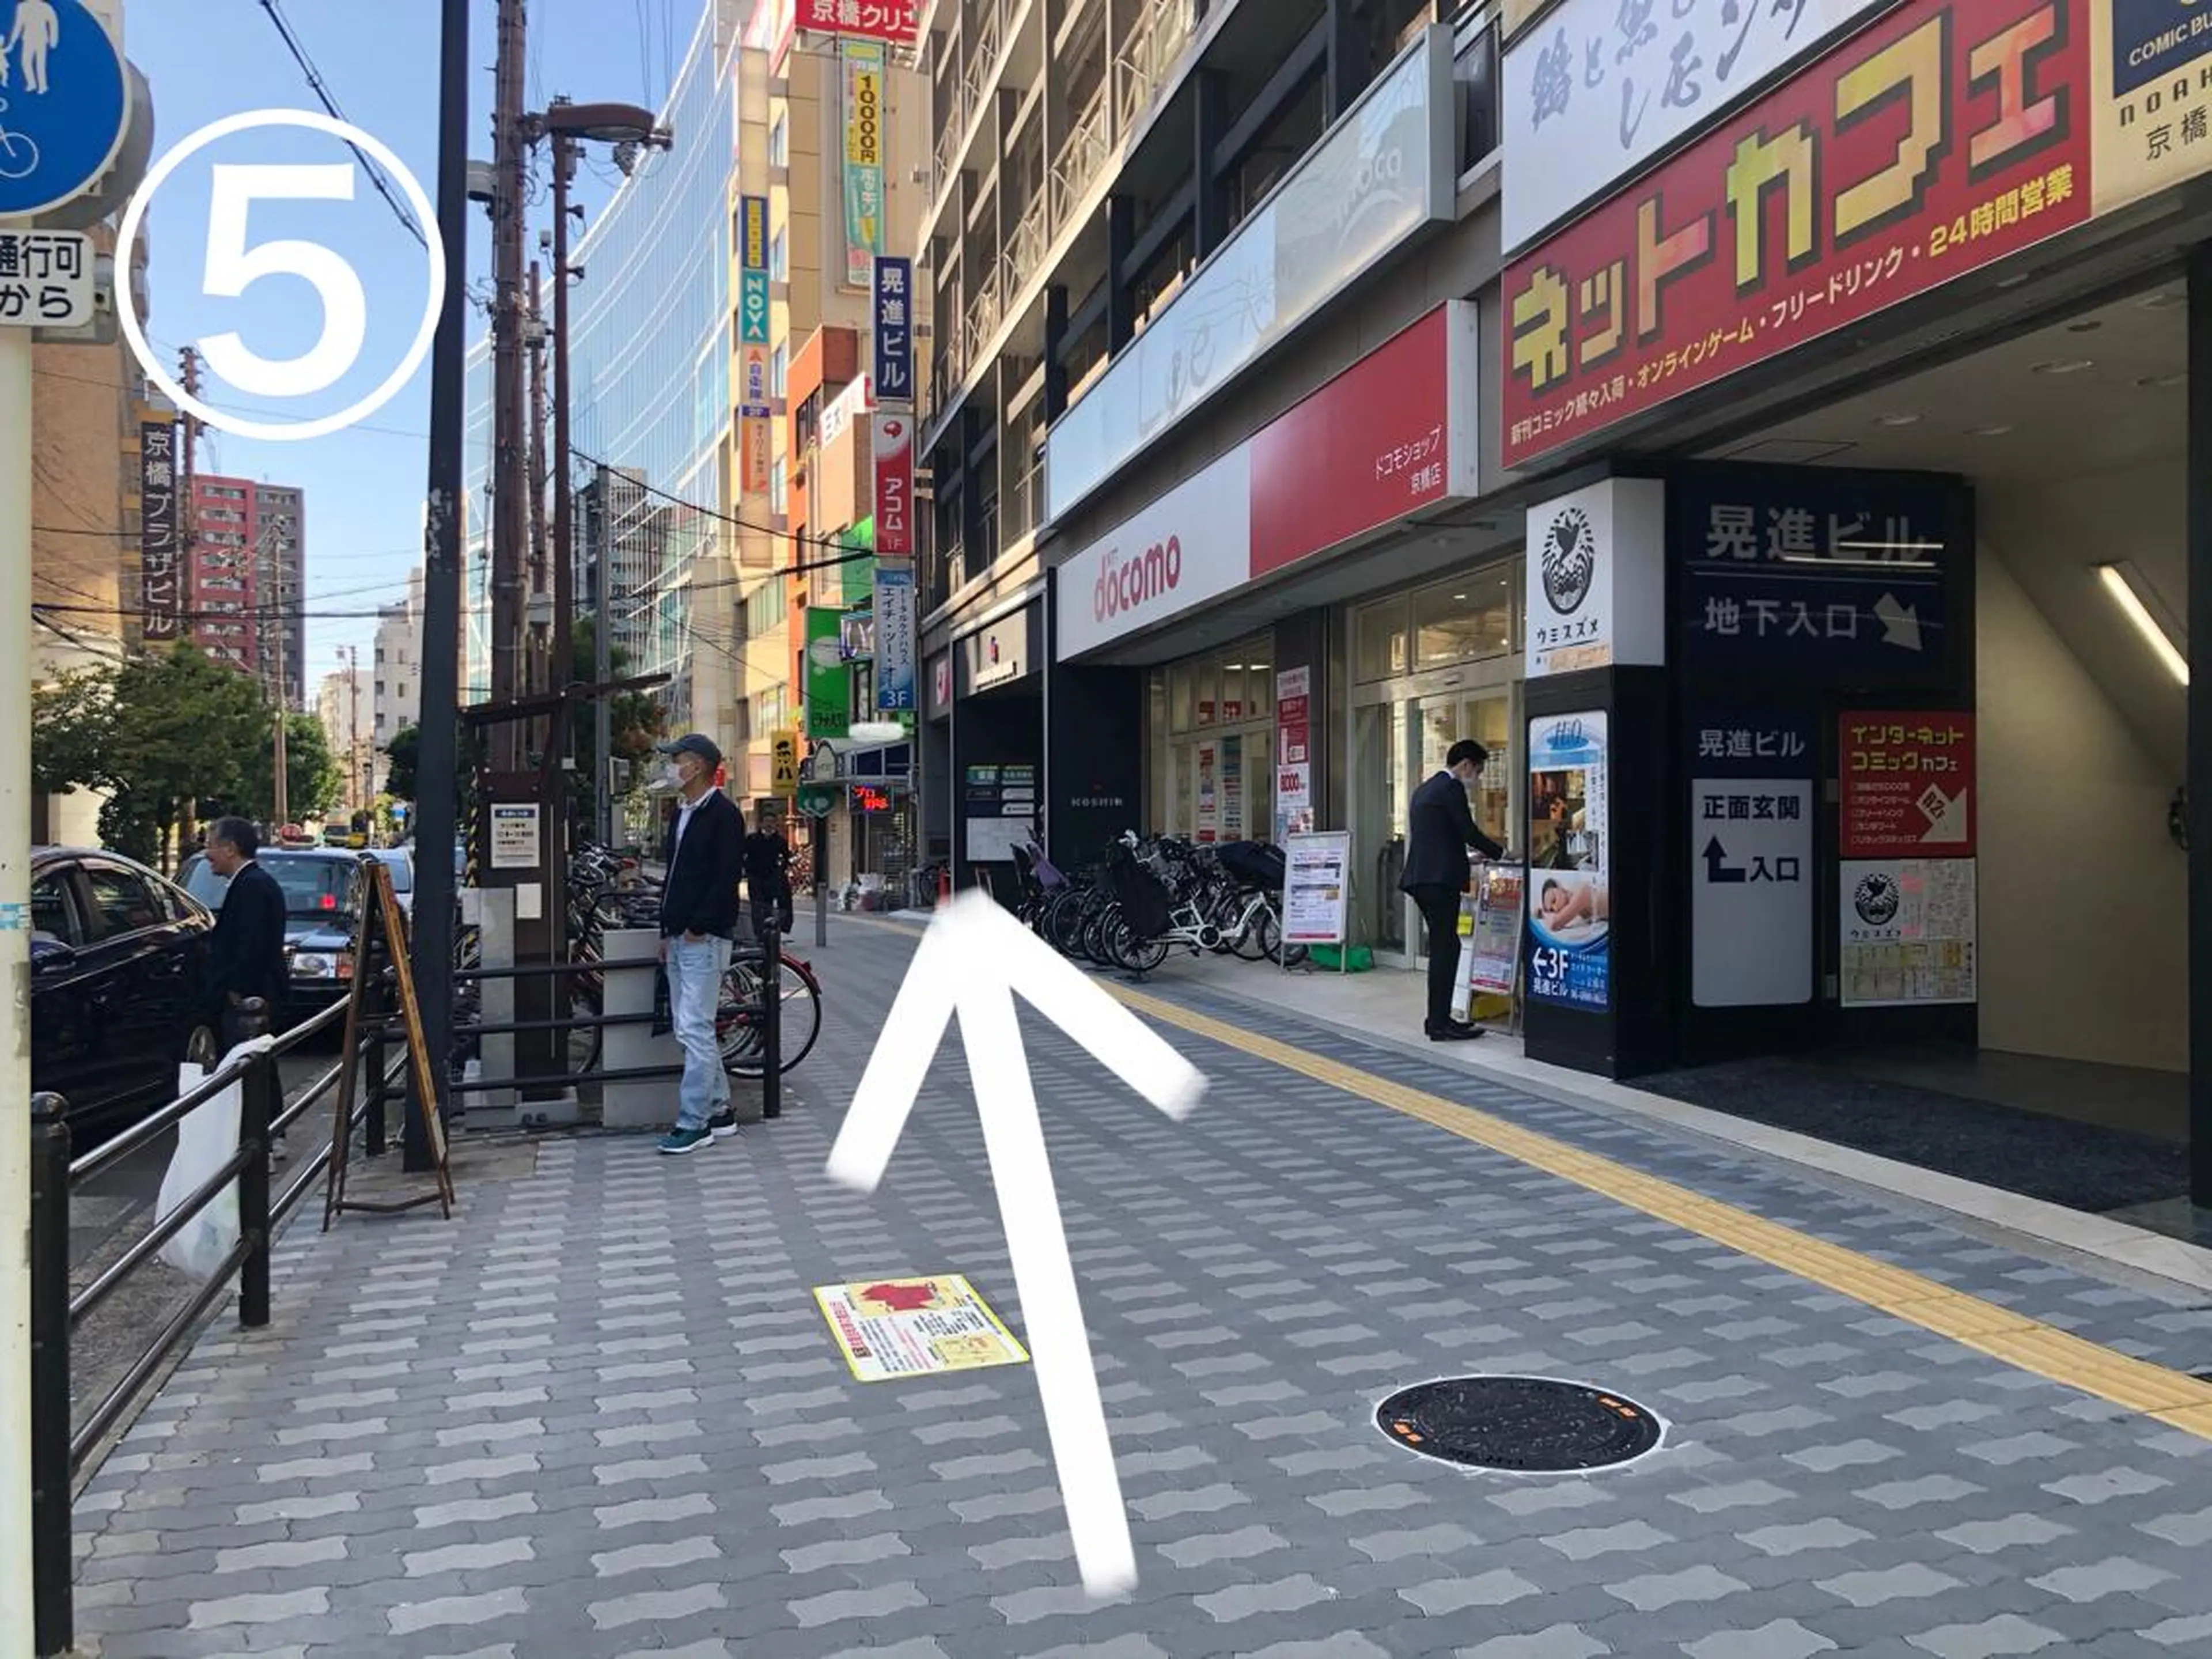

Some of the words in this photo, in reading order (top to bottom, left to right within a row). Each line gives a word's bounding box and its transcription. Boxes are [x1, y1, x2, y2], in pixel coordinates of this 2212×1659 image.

[2129, 24, 2188, 67] COMIC
[2146, 105, 2207, 162] 京橋
[1513, 3, 2056, 391] ネットカフェ
[747, 278, 764, 339] NOVA
[881, 267, 906, 388] 晃進ビル
[1376, 424, 1442, 481] ドコモショップ
[1411, 462, 1442, 495] 京橋店
[885, 477, 903, 531] アコム
[144, 430, 173, 634] 京橋プラザビル
[1706, 504, 1927, 562] 晃進ビル
[1094, 535, 1181, 624] docomo
[1536, 617, 1598, 644] ウミスズメ
[1704, 596, 1857, 639] 地下入口
[887, 691, 908, 707] 3F
[1698, 729, 1805, 757] 晃進ビル
[1851, 725, 1964, 745] インターネット
[1703, 794, 1801, 821] 正面玄関
[1749, 855, 1800, 883] 入口
[1548, 947, 1569, 979] 3F
